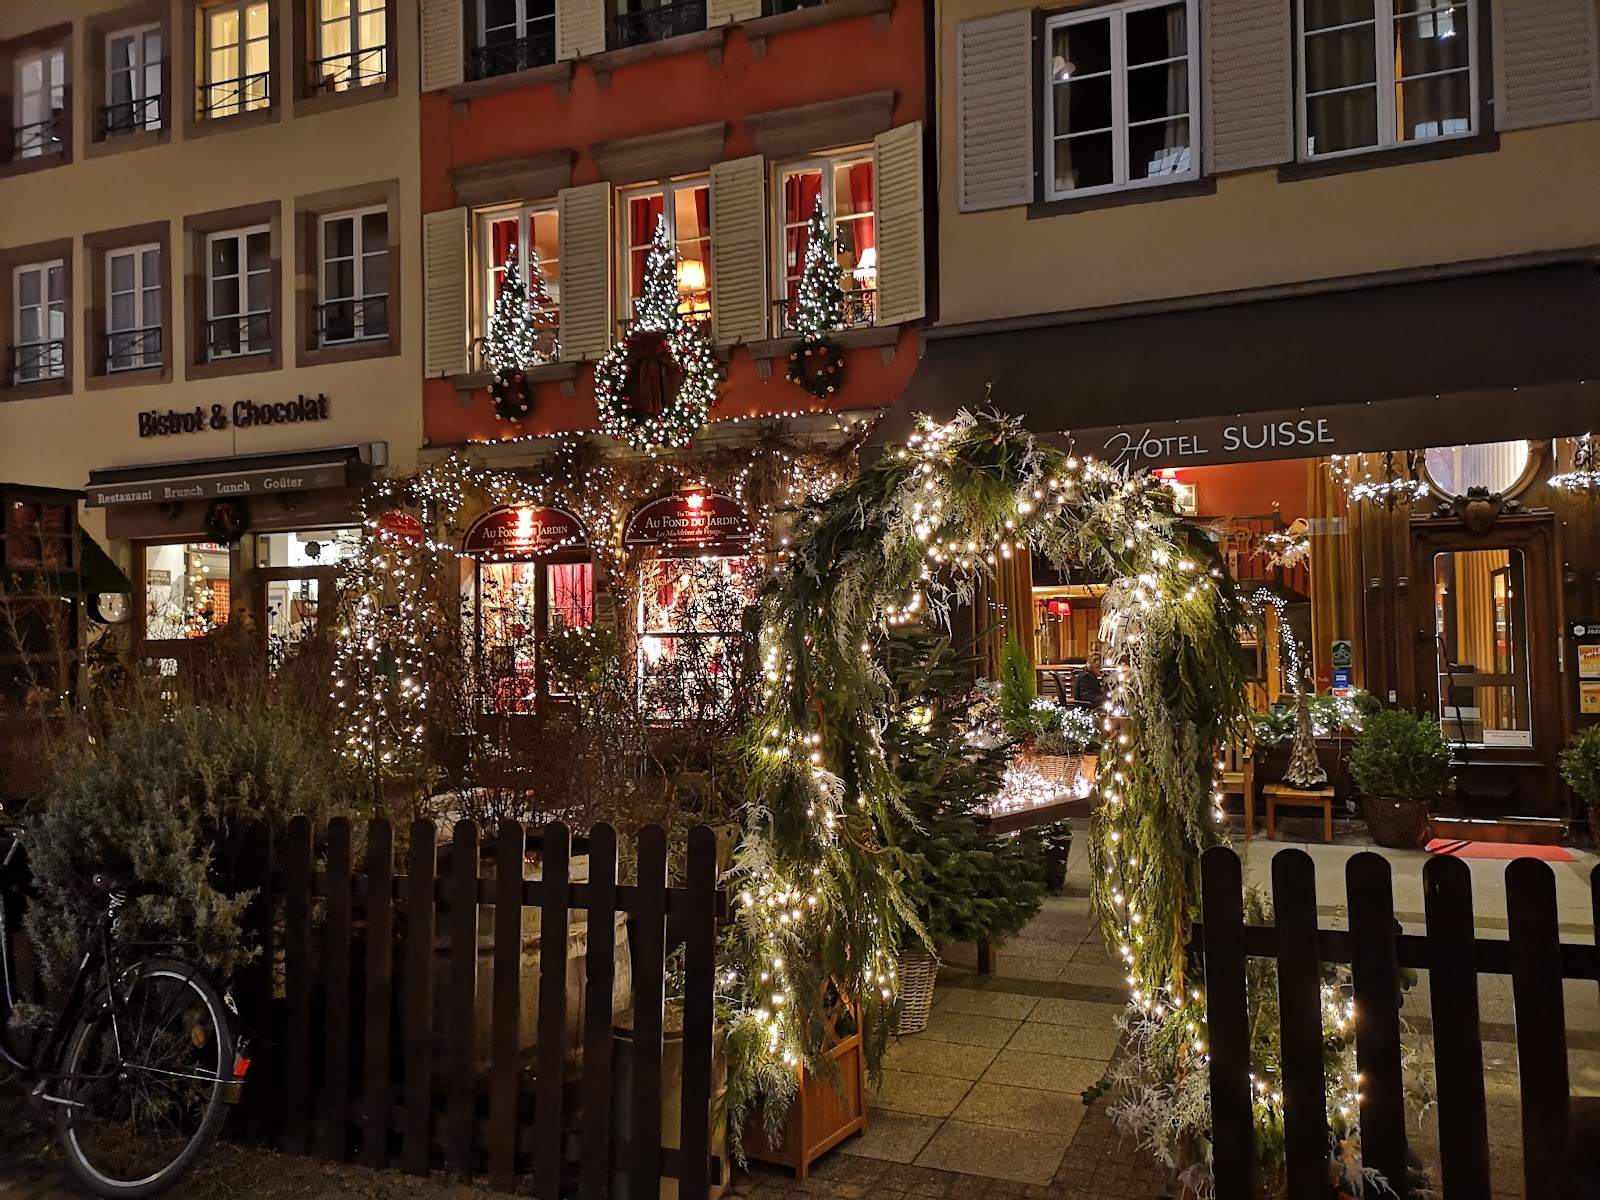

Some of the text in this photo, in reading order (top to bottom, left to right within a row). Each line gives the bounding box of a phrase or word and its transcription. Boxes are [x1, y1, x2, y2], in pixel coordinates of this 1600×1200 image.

[138, 394, 328, 437] Bistrot & Chocolat
[1223, 418, 1335, 451] SUISSE
[97, 477, 303, 504] Restaurant Brunch Lunch Goûter
